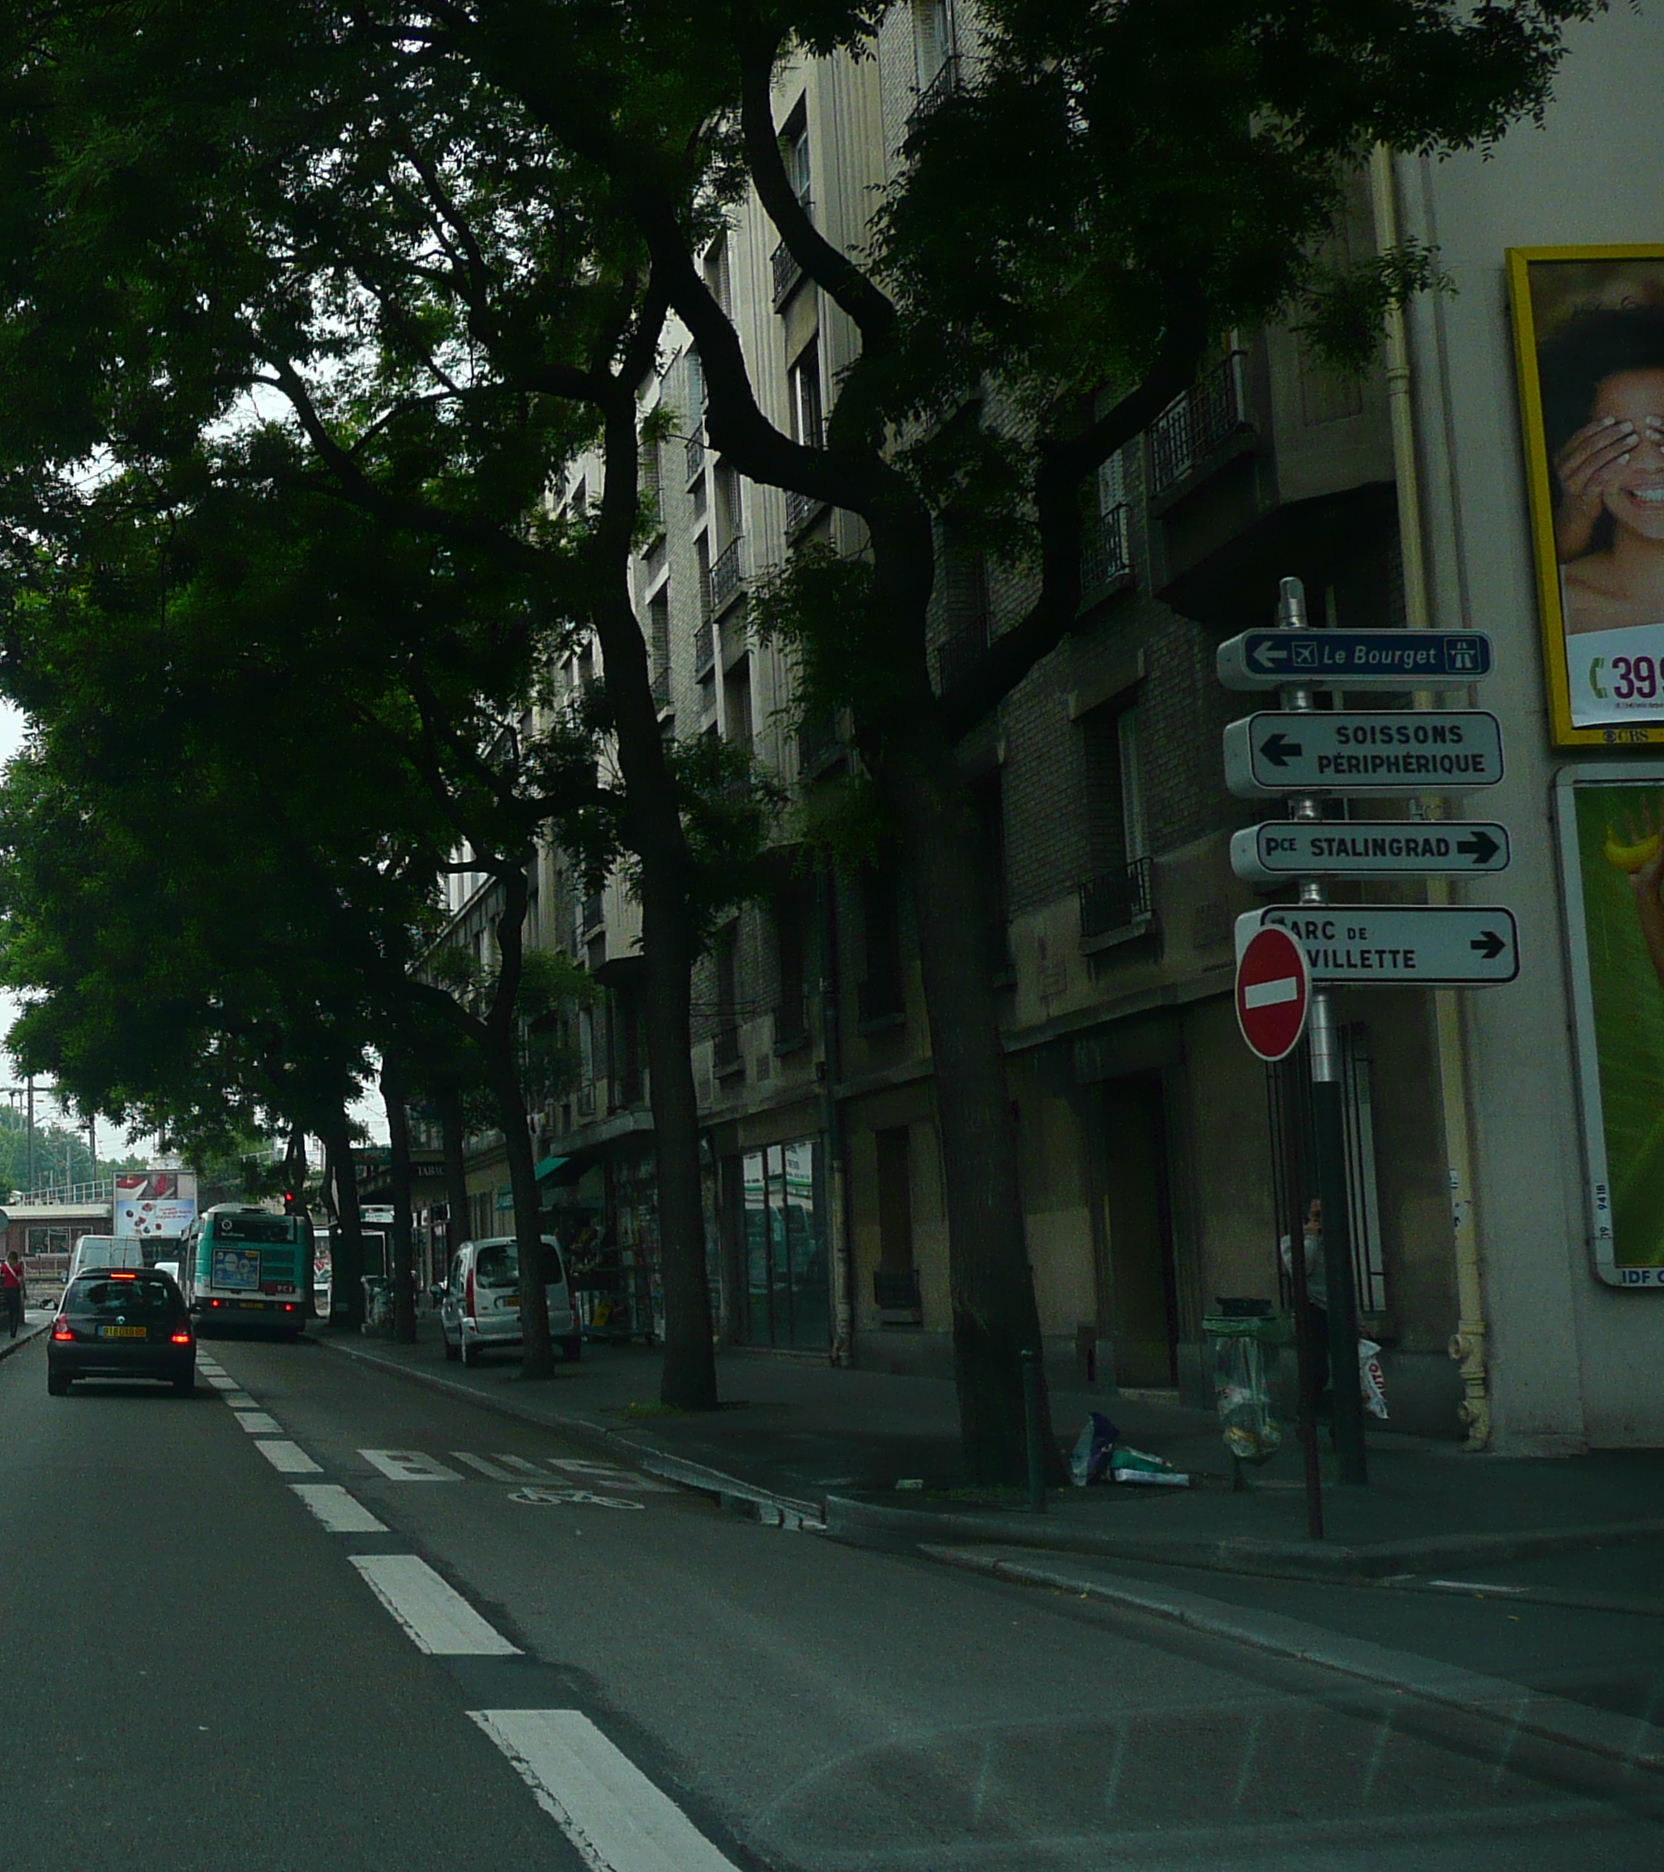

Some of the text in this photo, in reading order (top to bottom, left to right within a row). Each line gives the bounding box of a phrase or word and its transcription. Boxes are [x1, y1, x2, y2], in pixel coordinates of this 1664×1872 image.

[1323, 645, 1437, 669] Le Bourget
[1612, 656, 1664, 699] 39
[1336, 725, 1464, 745] SOISSONS
[1618, 729, 1649, 743] CBS
[1317, 752, 1485, 774] PÉRIPHÉRIQUE
[1310, 838, 1450, 857] STALINGRAD
[1286, 920, 1368, 940] ARC DE
[1308, 949, 1416, 969] VILLETTE
[1622, 1270, 1651, 1284] IDF
[355, 1448, 681, 1494] BUS
